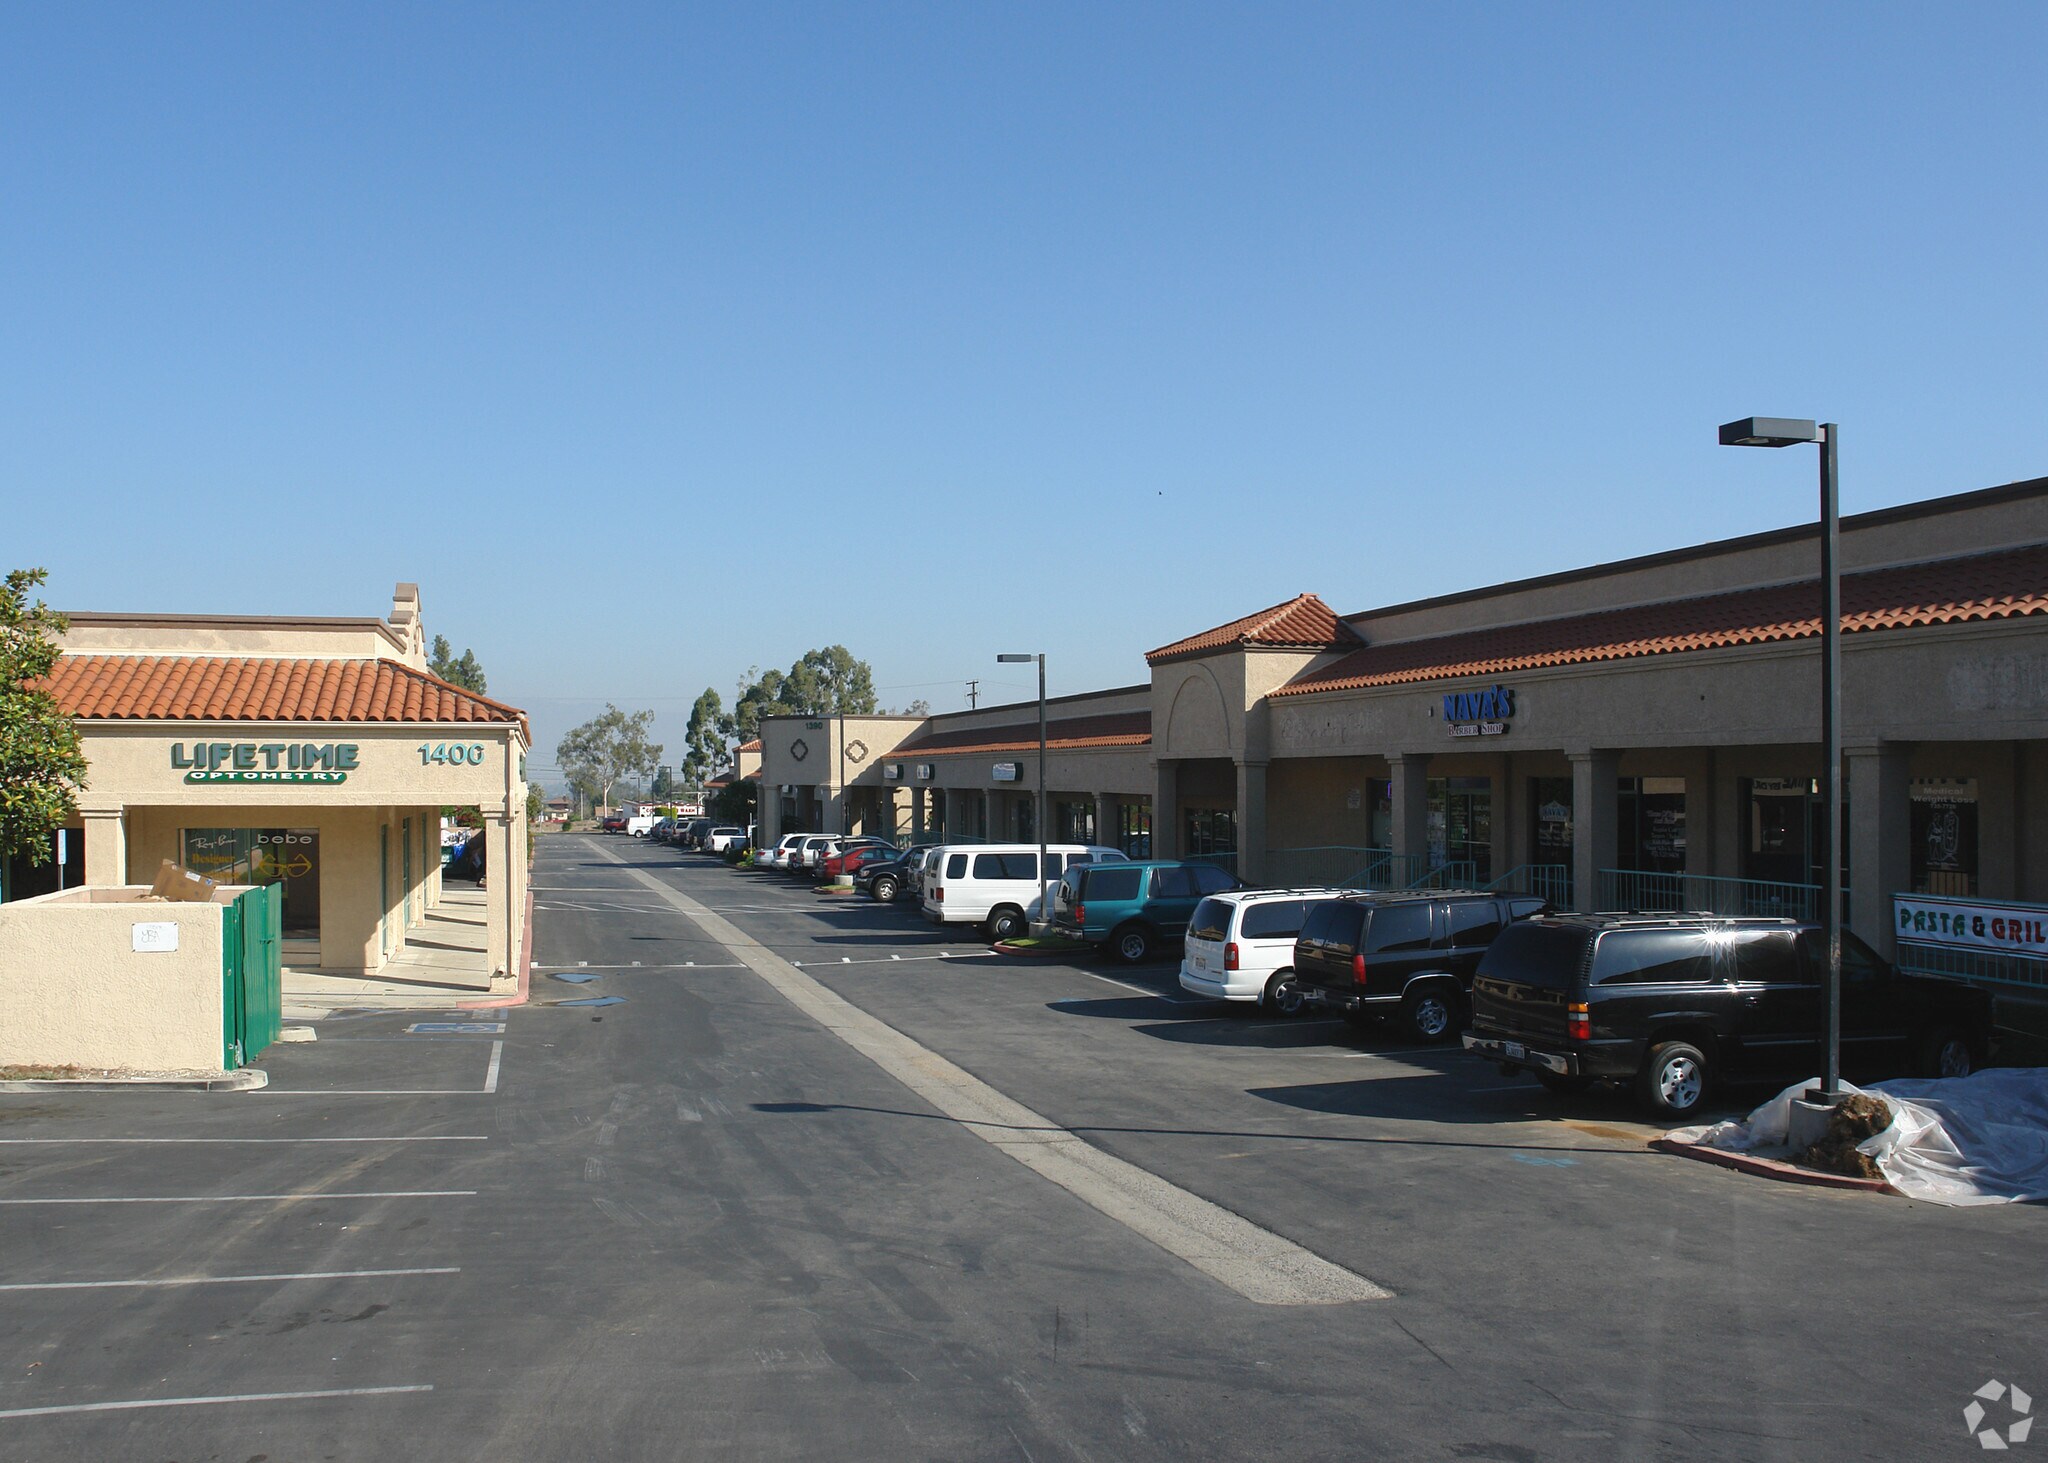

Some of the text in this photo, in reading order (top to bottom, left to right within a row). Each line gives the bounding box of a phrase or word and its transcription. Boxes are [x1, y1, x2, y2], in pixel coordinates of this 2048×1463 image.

[1443, 684, 1510, 721] NAVA'S
[1448, 721, 1505, 737] BARBER SHOP
[171, 742, 360, 771] LIFETIME
[417, 743, 485, 766] 1400
[190, 771, 343, 781] OPTOMETRY
[1923, 787, 1964, 795] Medical
[1912, 795, 1976, 804] Weight Loss
[190, 833, 313, 849] Ray-Ban bebe
[191, 853, 236, 864] Designer
[1900, 907, 1966, 937] PASTA
[1971, 915, 1986, 938] &
